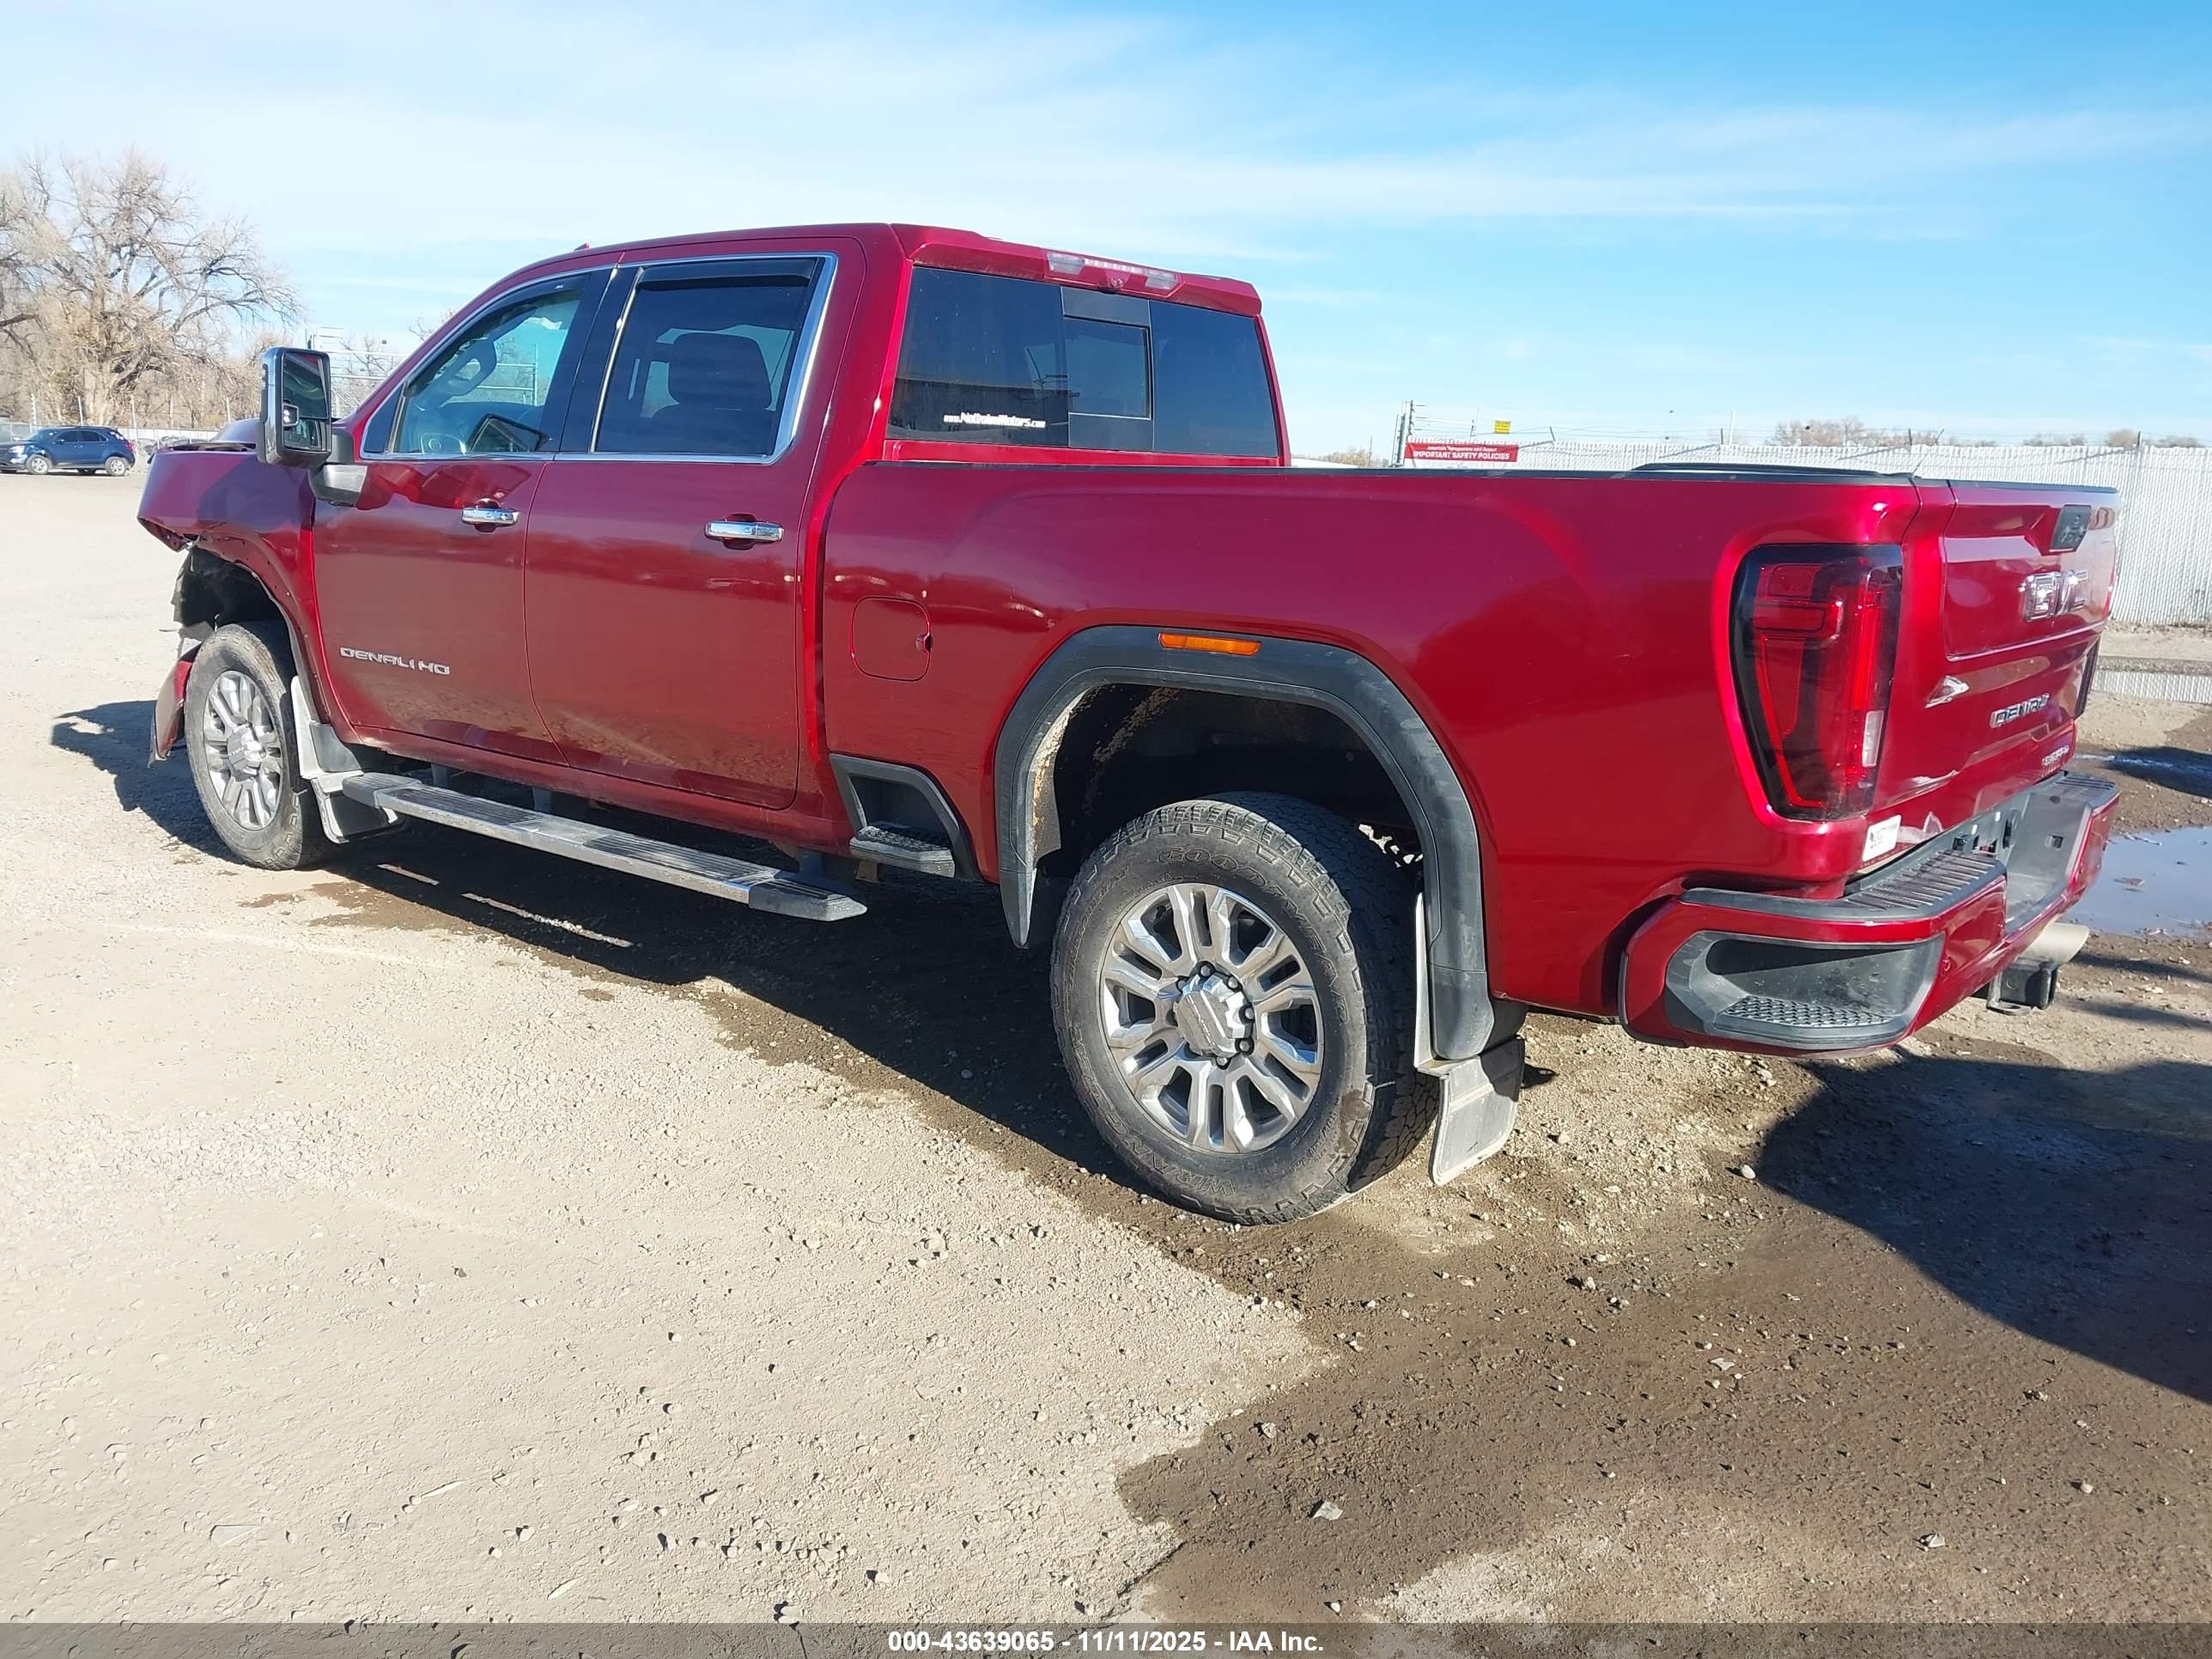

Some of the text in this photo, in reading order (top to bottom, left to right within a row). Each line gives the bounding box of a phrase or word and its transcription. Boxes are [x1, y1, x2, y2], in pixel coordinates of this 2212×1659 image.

[1413, 450, 1510, 460] IMPORTANT SAFETY POLICIES
[339, 647, 451, 675] DENALI HD
[1158, 847, 1349, 1024] GOODYEAR
[1070, 1024, 1237, 1196] WRANGLER
